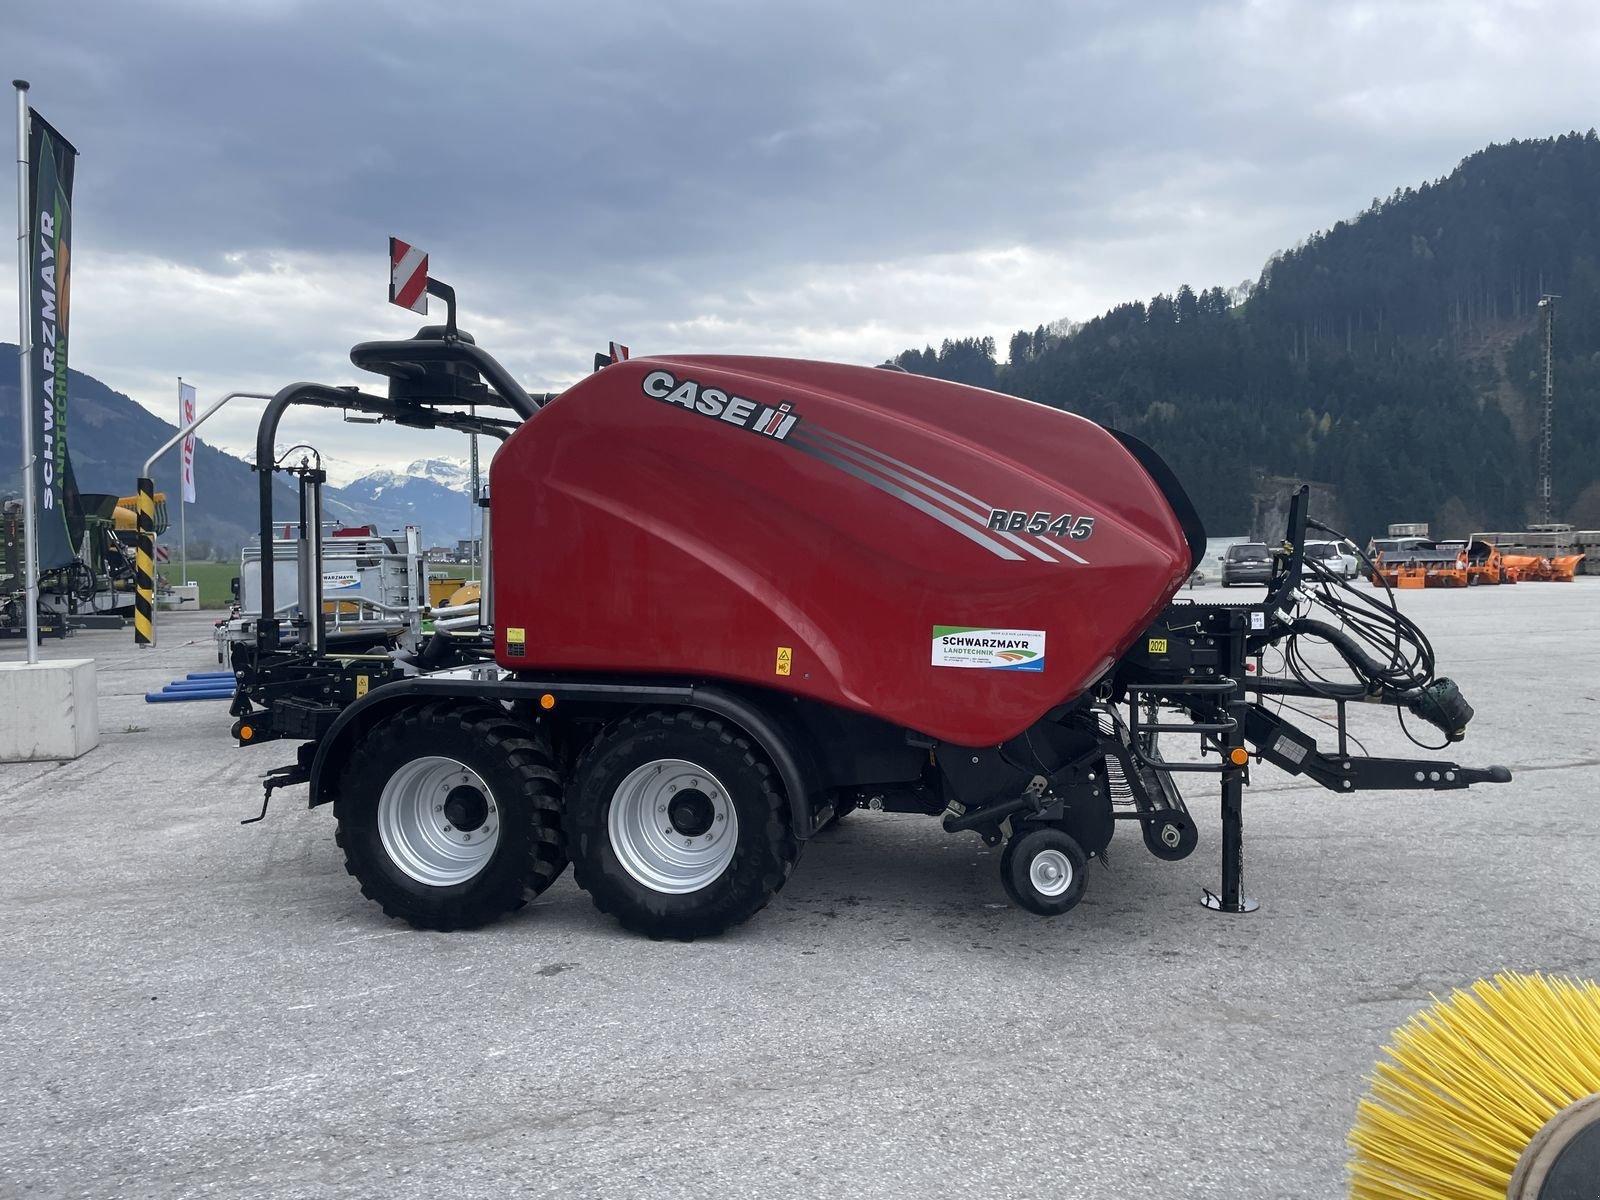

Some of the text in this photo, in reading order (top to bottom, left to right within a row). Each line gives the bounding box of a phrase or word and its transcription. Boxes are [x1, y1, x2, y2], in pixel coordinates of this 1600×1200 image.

[41, 210, 56, 510] SCHWARZMAYR
[643, 371, 757, 426] CASE
[986, 508, 1095, 540] RB545
[942, 636, 1029, 649] SCHWARZMAYR
[943, 647, 994, 656] LANDTECHNIK
[1150, 640, 1166, 652] 2021
